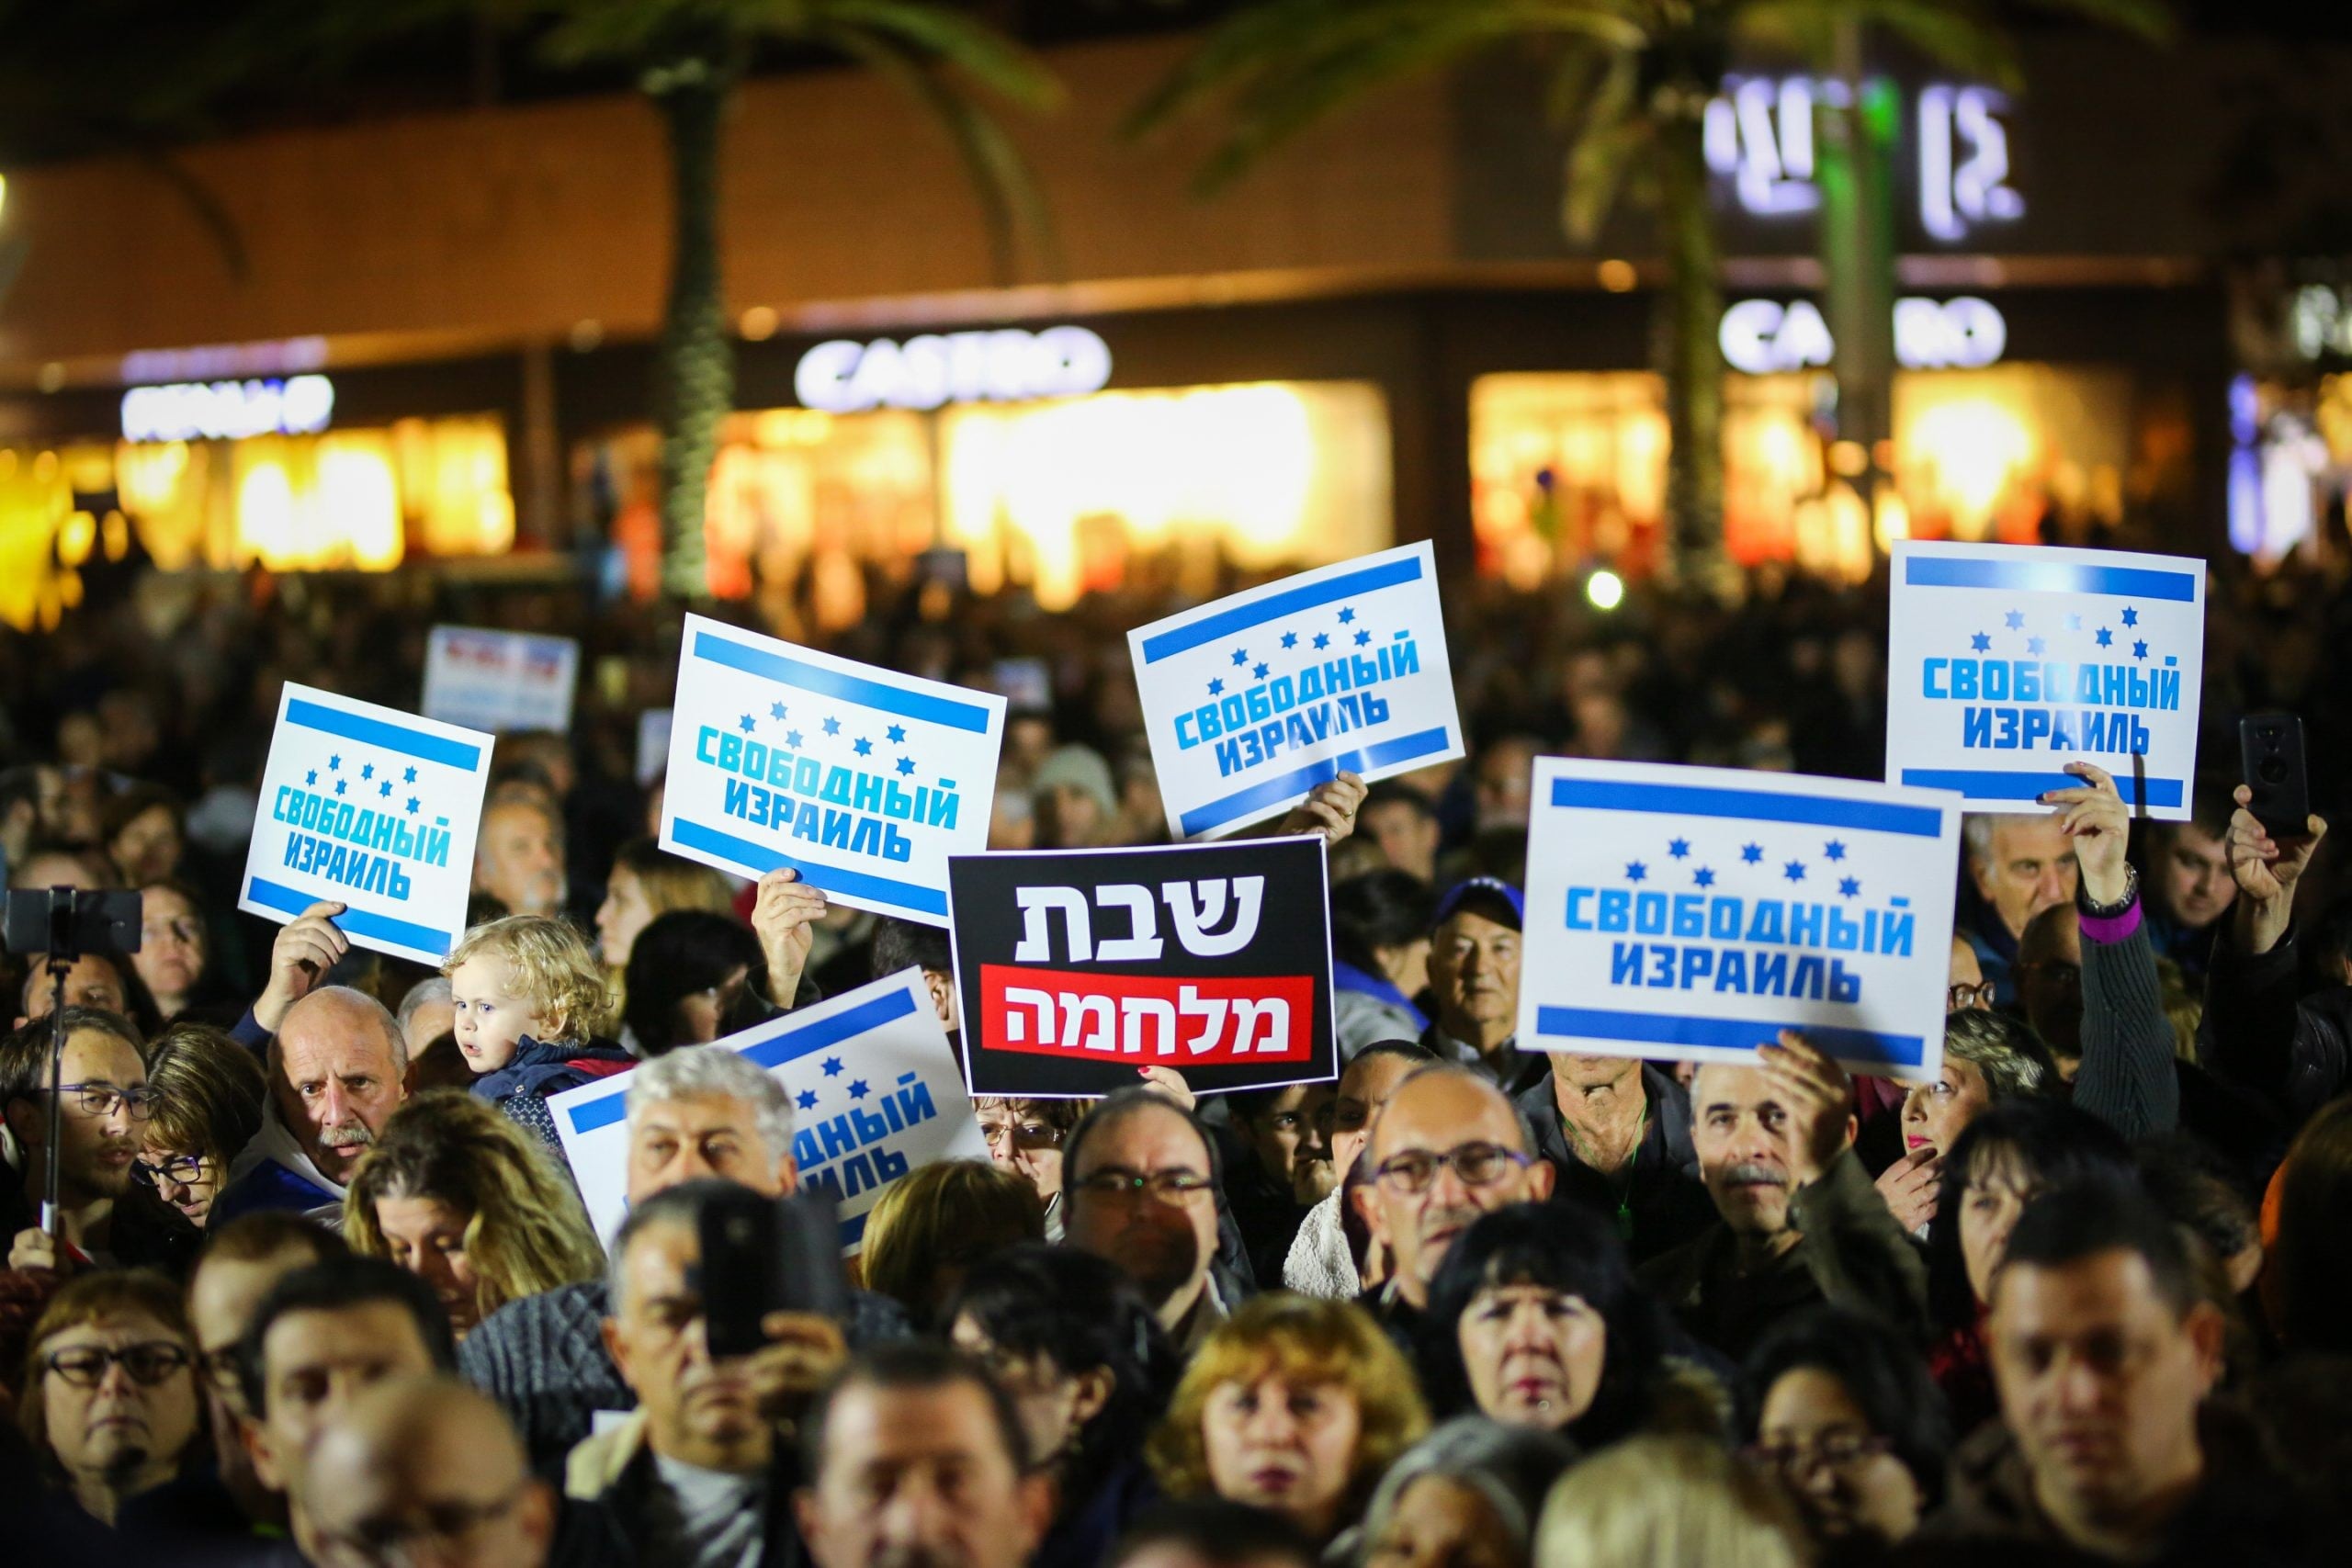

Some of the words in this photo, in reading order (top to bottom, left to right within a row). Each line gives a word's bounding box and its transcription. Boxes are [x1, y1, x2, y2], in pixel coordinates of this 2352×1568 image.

[1719, 295, 2007, 373] CARO
[1173, 629, 1420, 751] СВОБОДНЫЙ
[1922, 656, 2180, 711] СВОБОДНЫЙ
[1215, 691, 1390, 778] ИЗРАИЛЬ
[1963, 706, 2150, 755] ИЗРАИЛЬ
[695, 724, 960, 830] СВОБОДНЫЙ
[273, 784, 451, 868] СВОБОДНЫЙ
[723, 777, 911, 863] ИЗРАИЛЬ
[283, 830, 412, 901] ИЗРАИЛЬ
[1014, 875, 1265, 963] שבת
[1565, 885, 1916, 957] СВОБОДНЫЙ
[1611, 942, 1862, 1005] ИЗРАИЛЬ
[1004, 985, 1290, 1056] מלחמה
